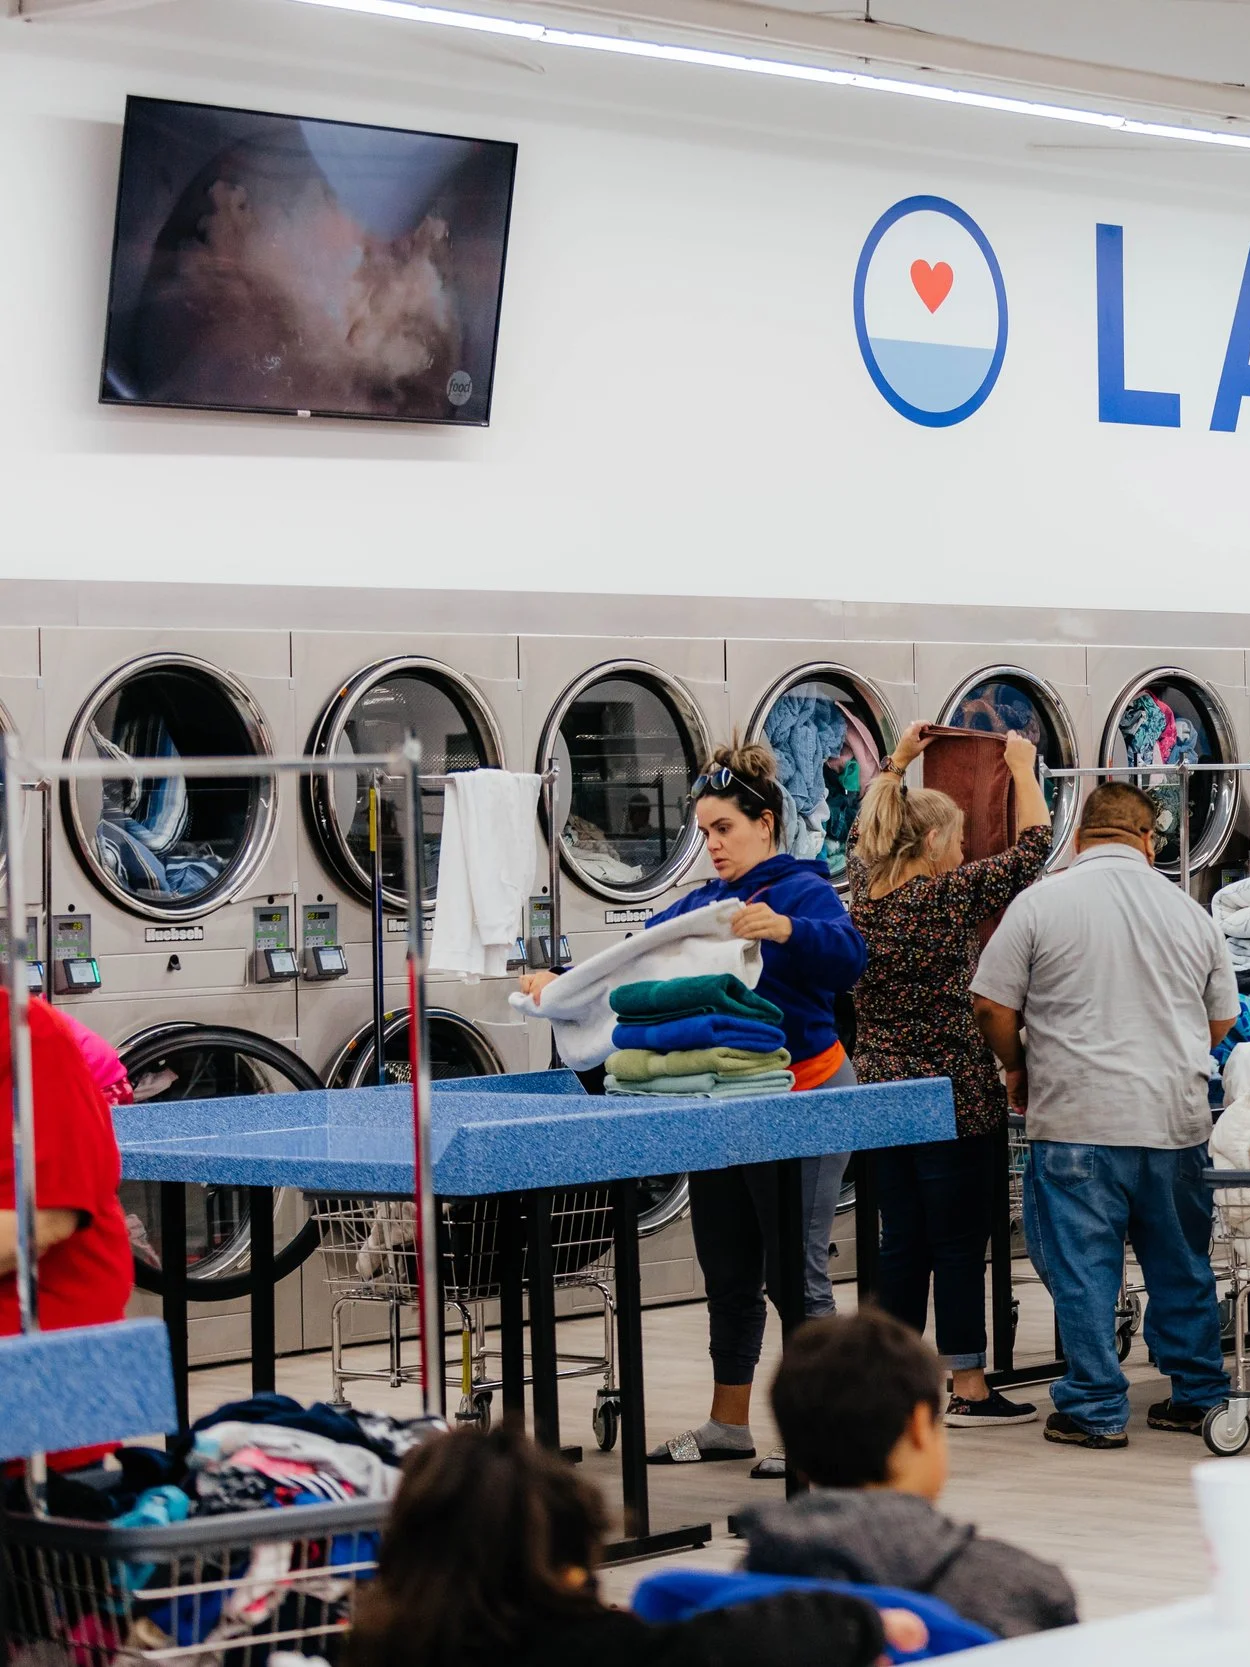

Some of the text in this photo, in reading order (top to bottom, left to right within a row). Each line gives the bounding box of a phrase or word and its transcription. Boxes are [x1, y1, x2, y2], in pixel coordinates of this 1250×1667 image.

[448, 379, 471, 396] food
[606, 909, 653, 923] Huebsch
[388, 919, 432, 931] Huec
[146, 927, 203, 941] Huebsch
